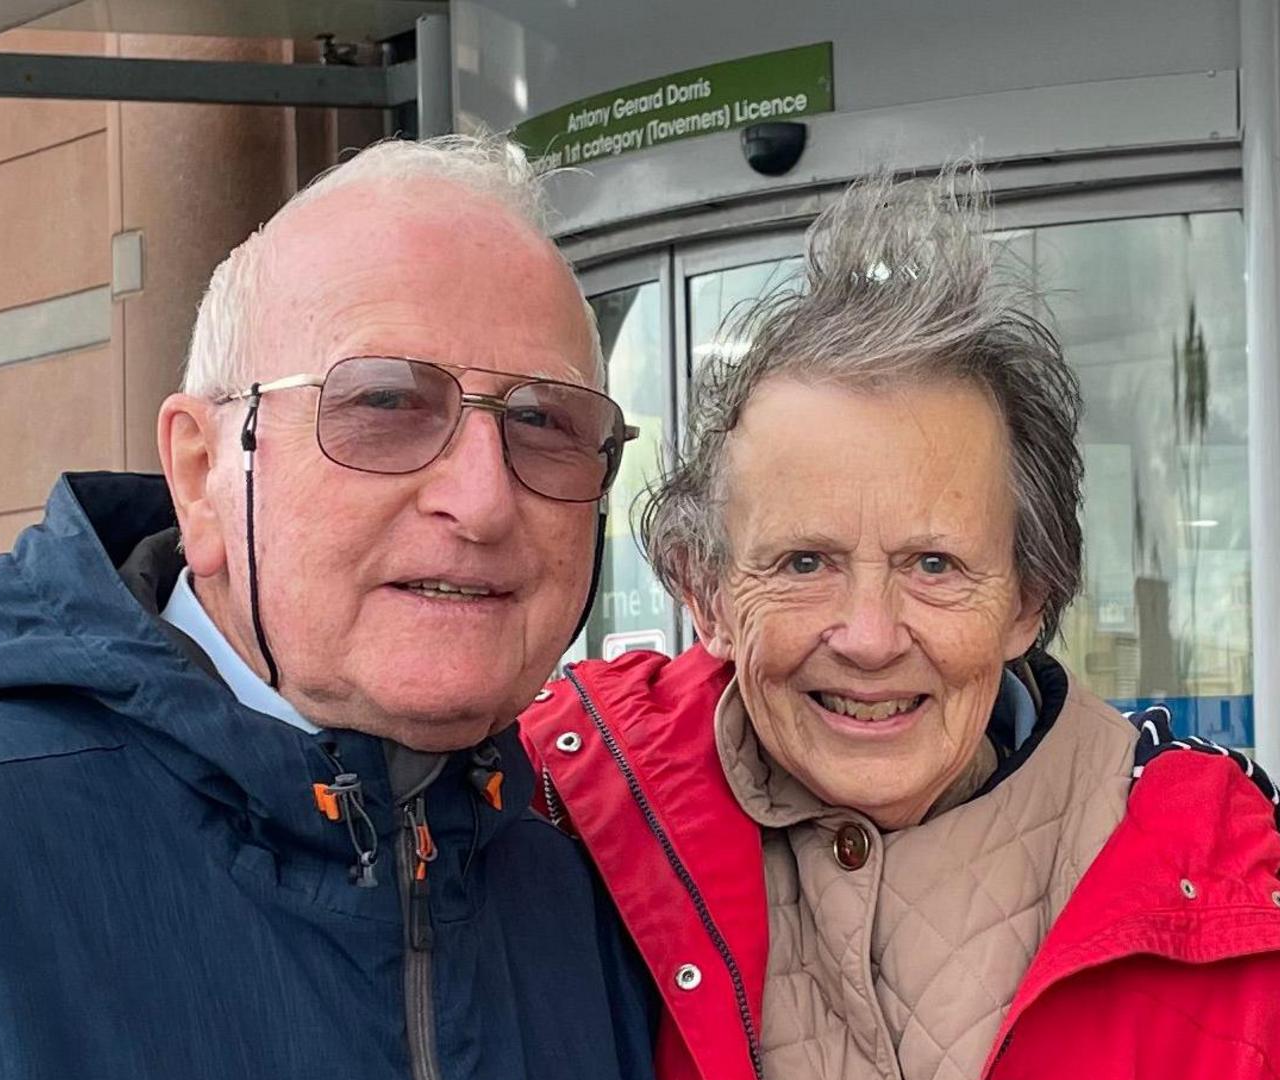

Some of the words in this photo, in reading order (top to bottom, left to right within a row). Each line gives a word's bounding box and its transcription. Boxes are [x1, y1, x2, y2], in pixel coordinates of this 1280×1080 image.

[567, 104, 611, 133] Antony
[613, 88, 663, 120] Gerard
[583, 123, 645, 159] category
[648, 104, 730, 145] (Taverners)
[735, 92, 808, 123] Licence
